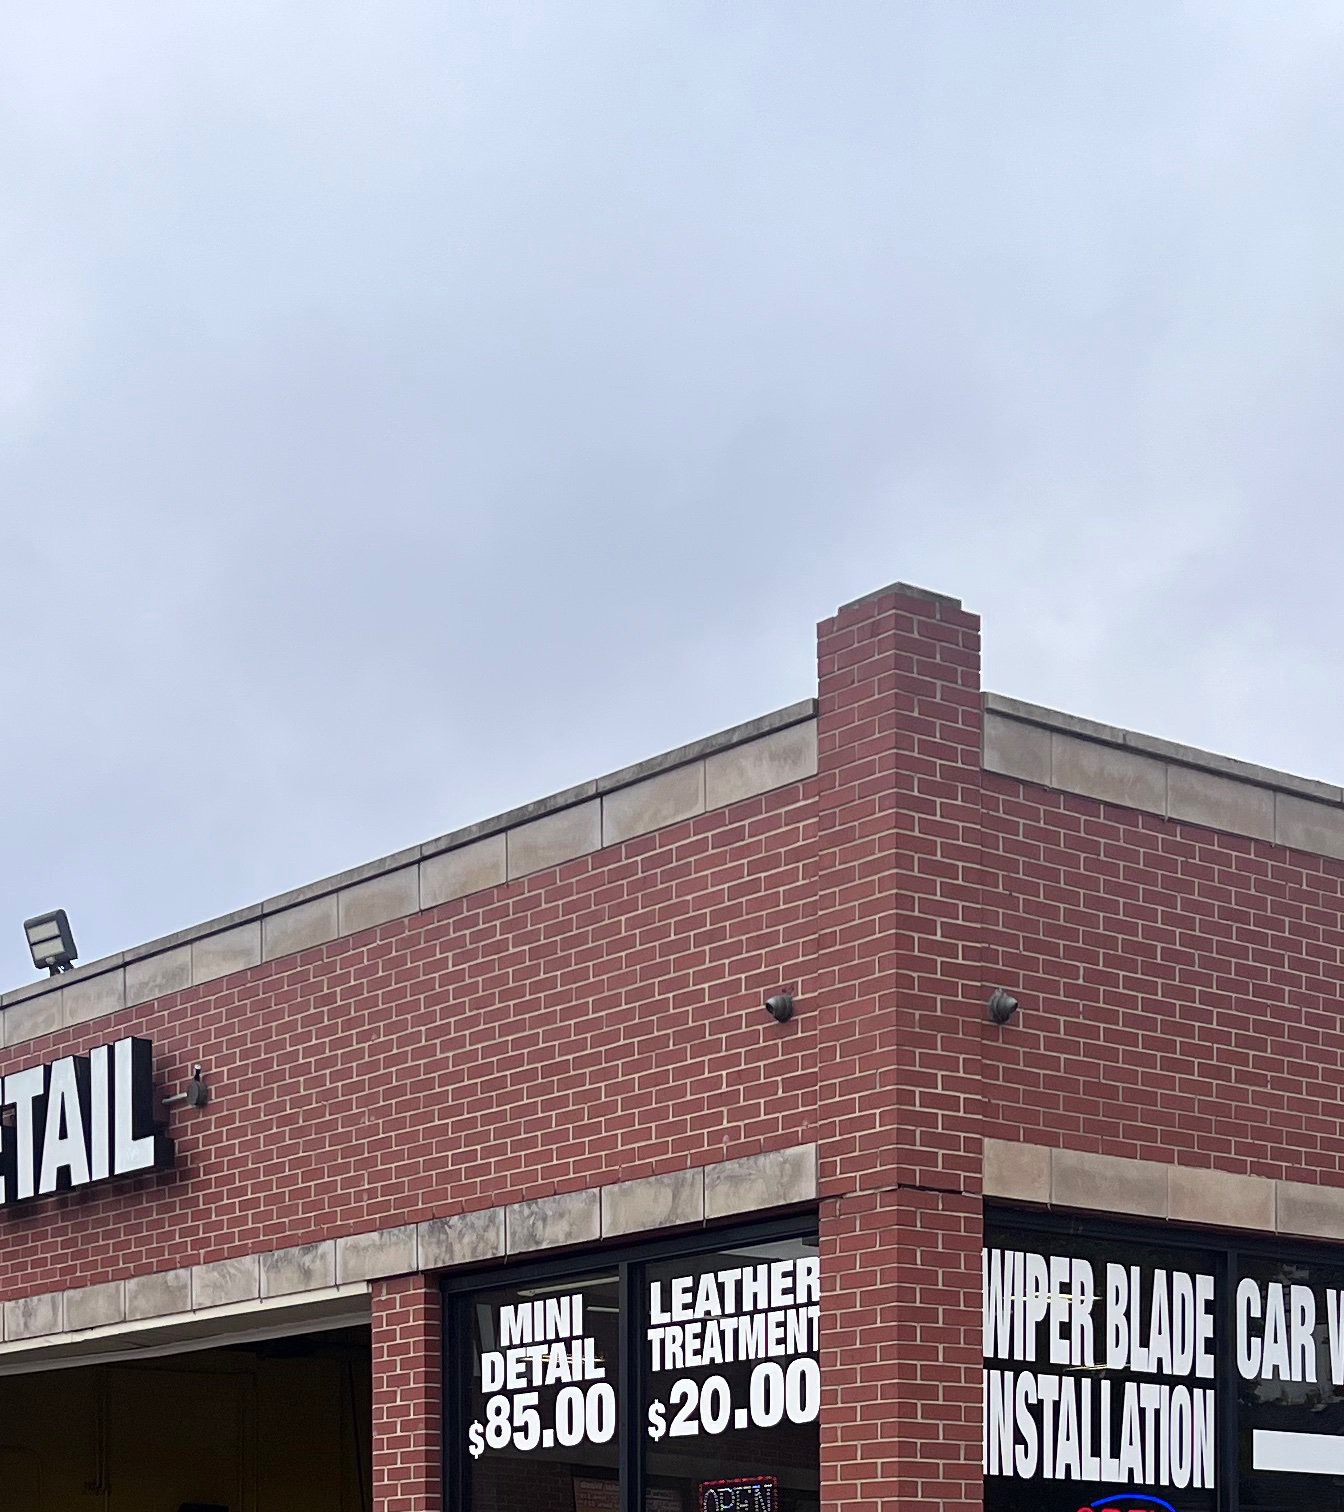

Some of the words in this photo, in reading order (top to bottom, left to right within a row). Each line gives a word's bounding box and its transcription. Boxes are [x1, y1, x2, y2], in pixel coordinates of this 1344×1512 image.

[500, 1293, 583, 1347] MINI
[650, 1257, 820, 1325] LEATHER
[983, 1247, 1094, 1367] WIPER
[1107, 1263, 1214, 1378] BLADE
[481, 1337, 605, 1393] DETAIL
[647, 1305, 820, 1372] TREATMENT
[1236, 1277, 1317, 1383] CAR
[468, 1382, 616, 1459] $85.00
[648, 1357, 820, 1442] $20.00
[983, 1369, 1215, 1489] INSTALLATION
